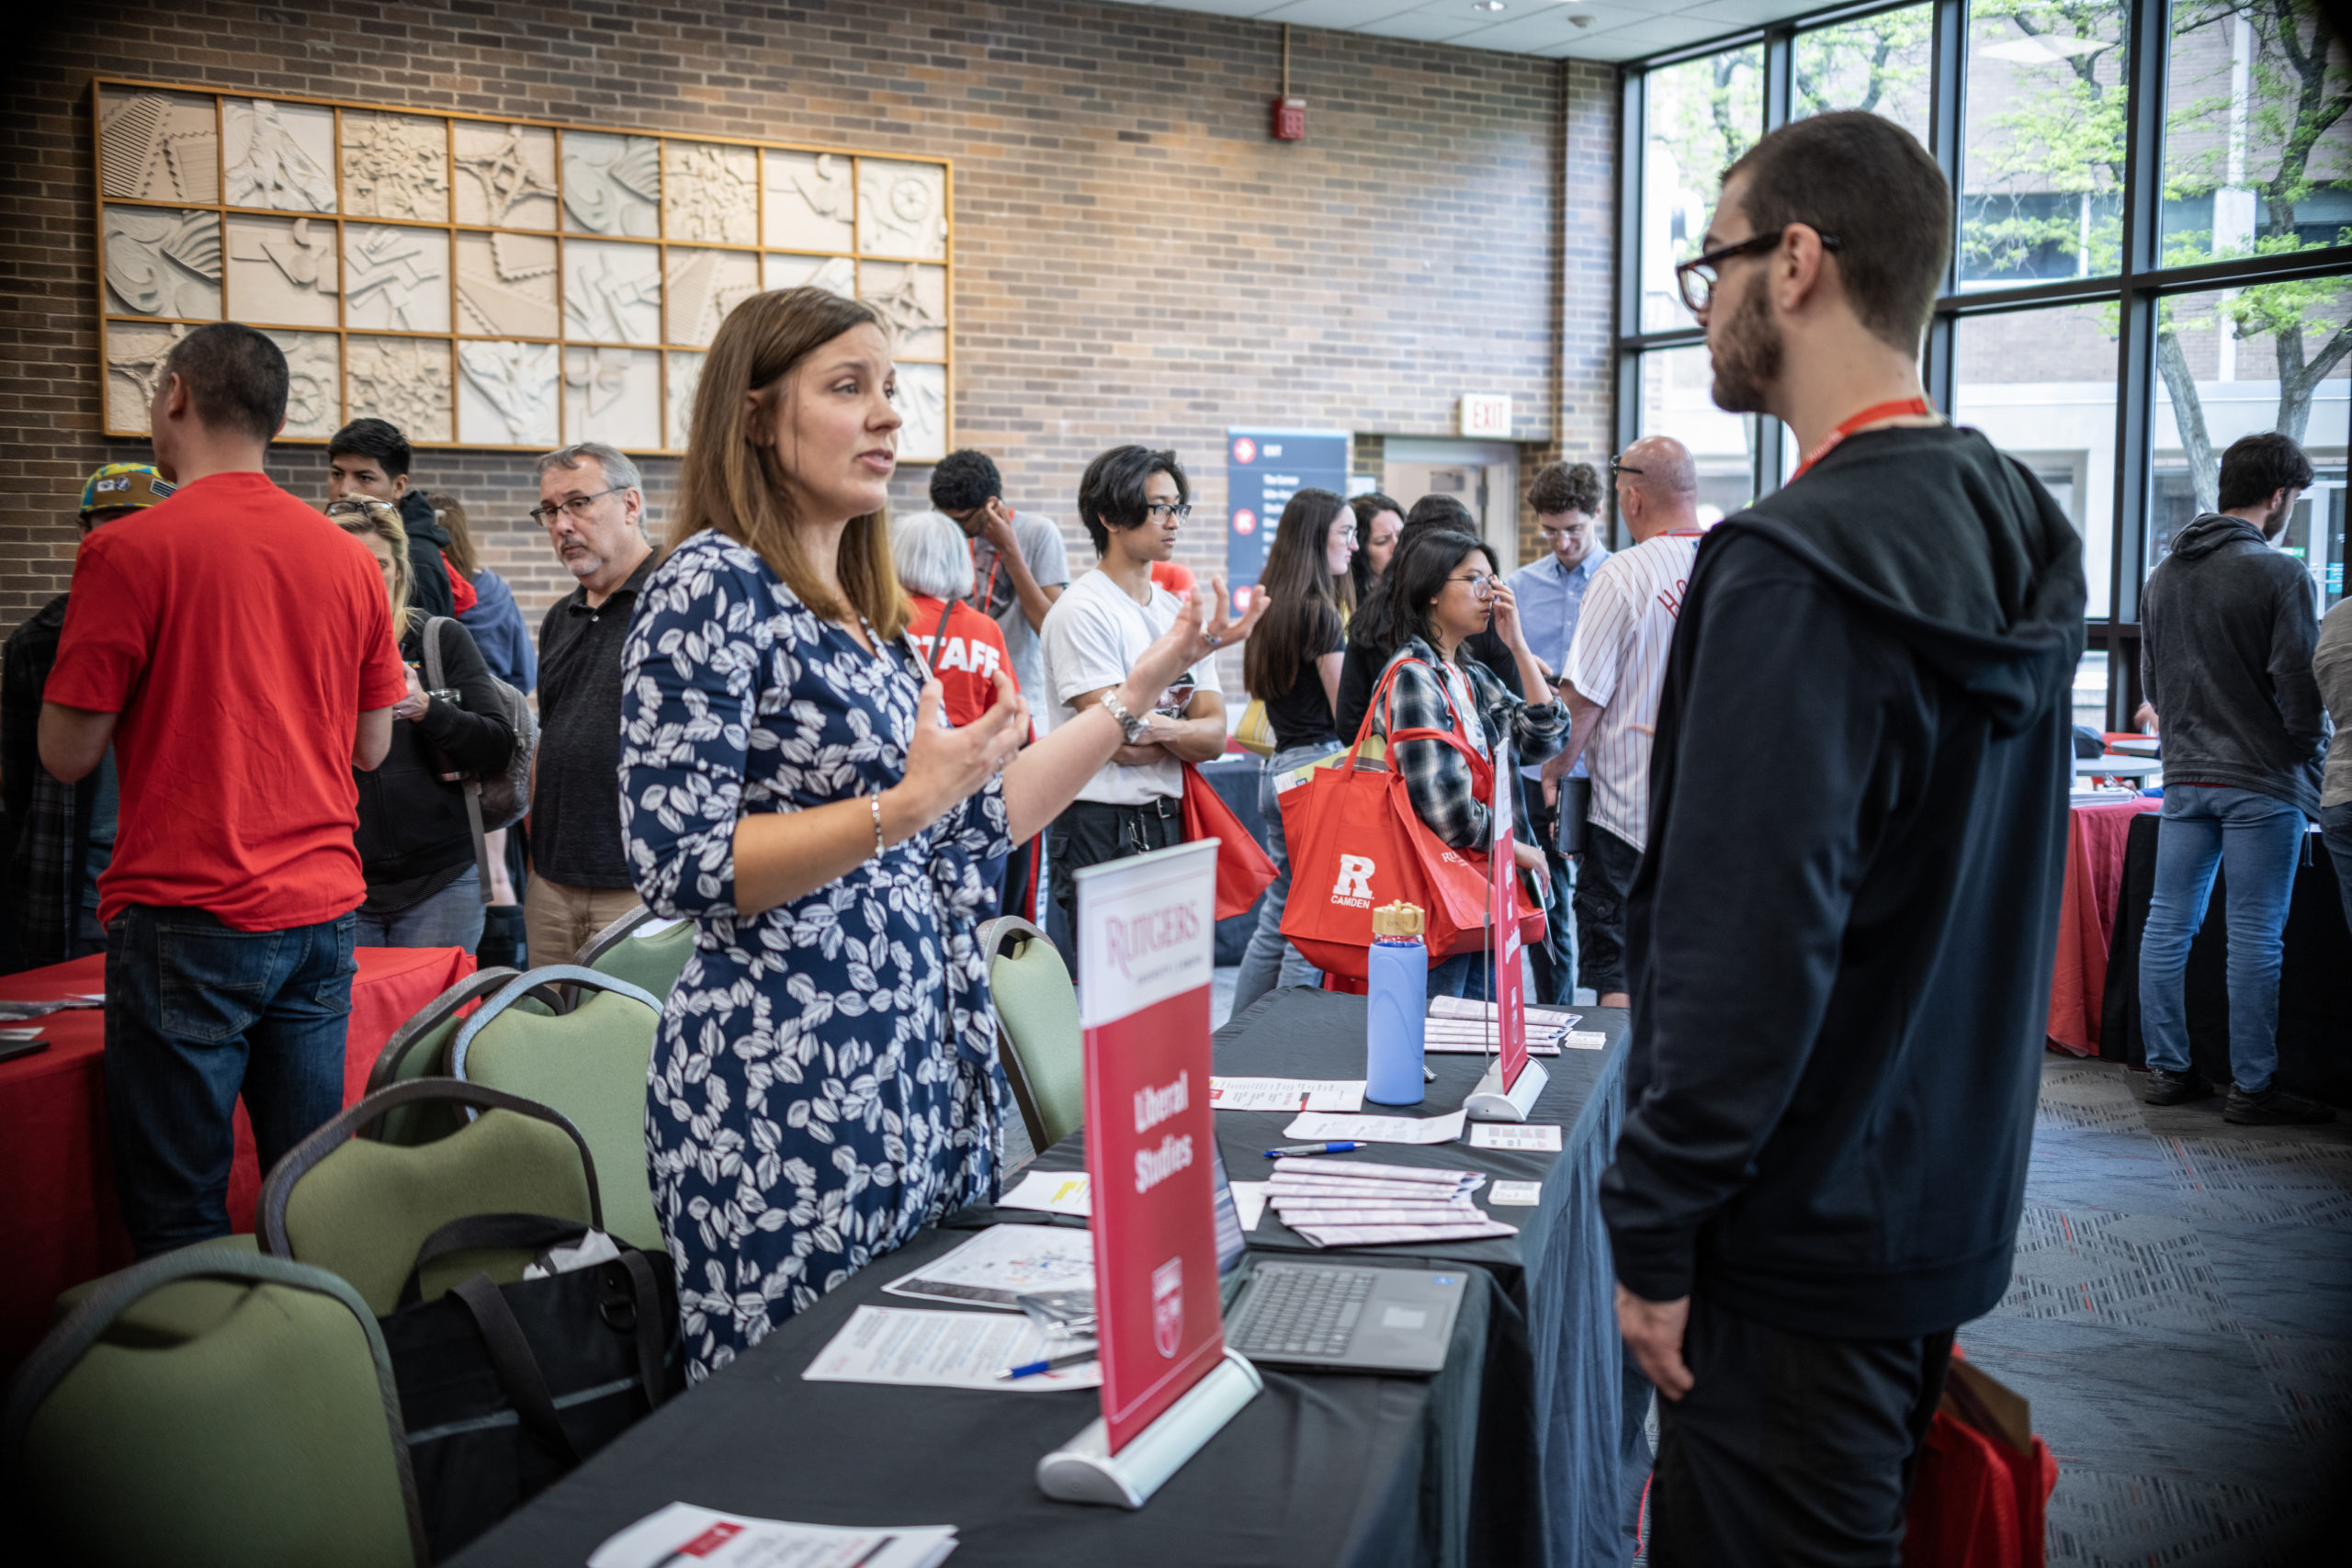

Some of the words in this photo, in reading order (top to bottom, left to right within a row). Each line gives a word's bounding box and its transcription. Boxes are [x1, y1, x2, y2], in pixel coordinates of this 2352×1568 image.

[1473, 400, 1504, 430] EXIT
[1330, 895, 1370, 909] CAMDEN
[1333, 853, 1375, 899] R
[1104, 900, 1201, 982] RUTGERS
[1134, 1068, 1189, 1134] Liberal
[1134, 1134, 1193, 1193] Studies
